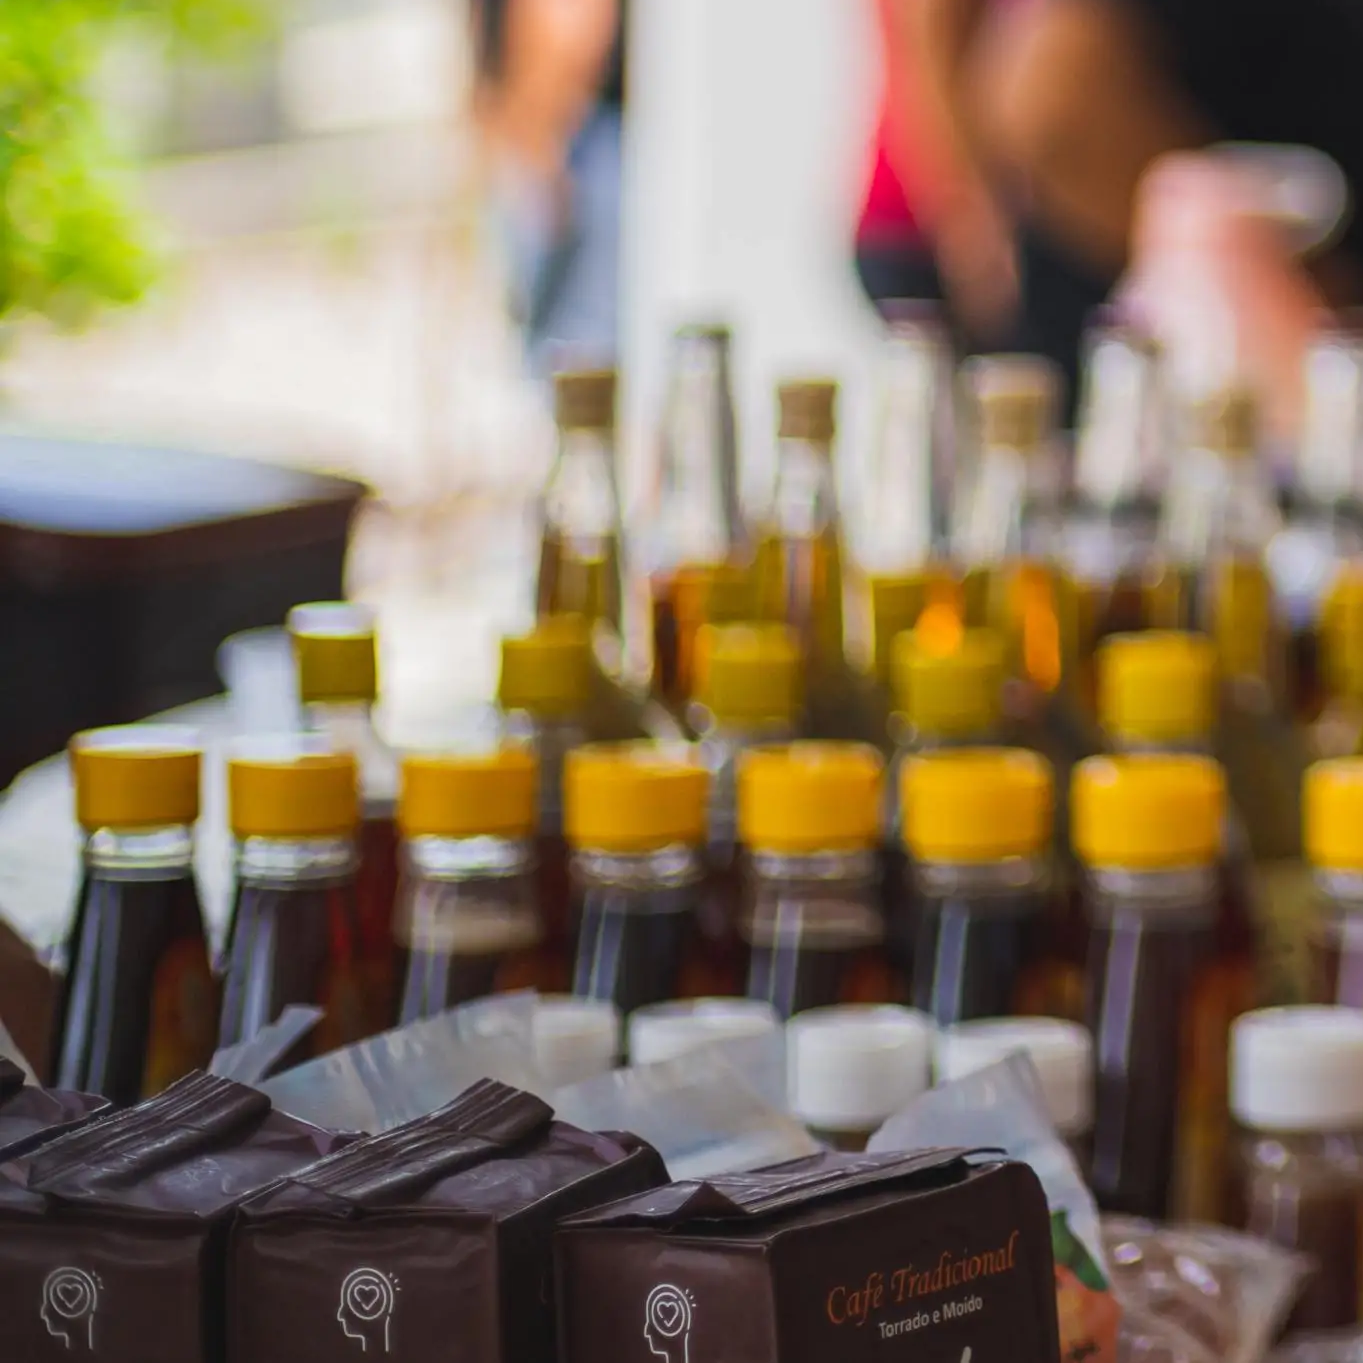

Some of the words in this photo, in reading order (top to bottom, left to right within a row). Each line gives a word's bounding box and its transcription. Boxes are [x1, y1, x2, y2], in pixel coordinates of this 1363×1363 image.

[826, 1271, 885, 1327] Café
[890, 1229, 1020, 1303] Tradicional
[878, 1309, 930, 1339] Torrado
[932, 1310, 941, 1324] e
